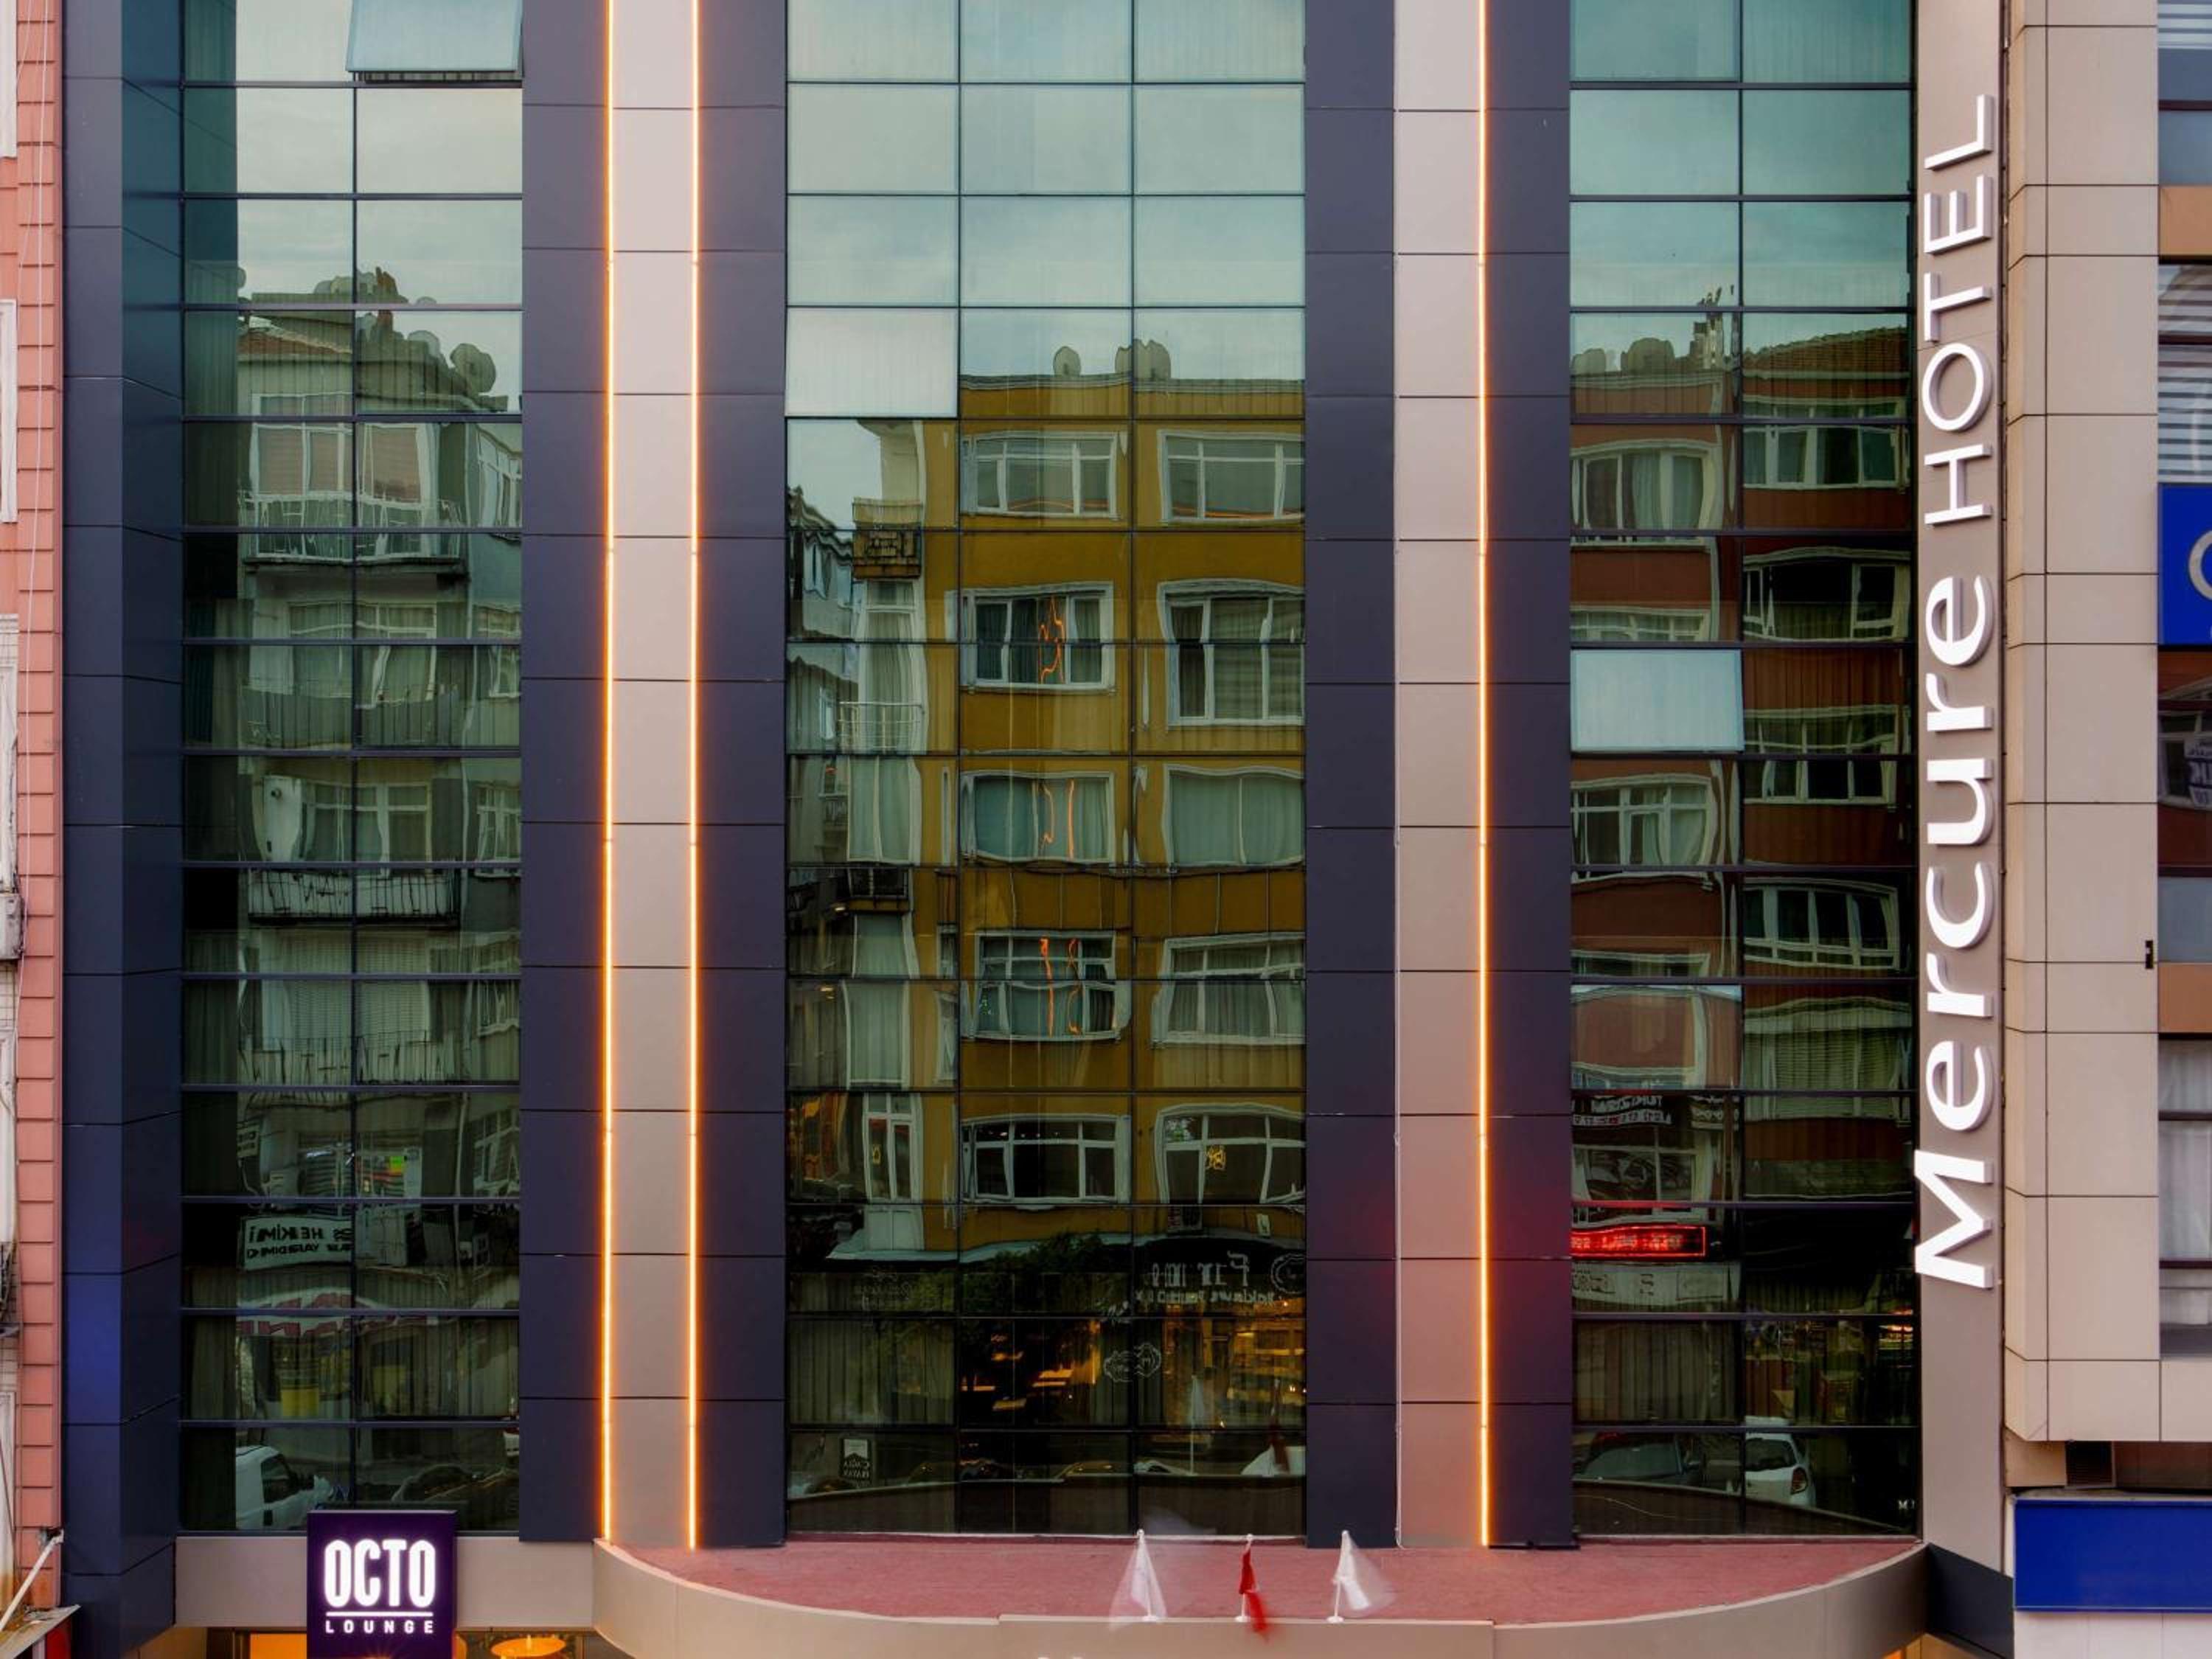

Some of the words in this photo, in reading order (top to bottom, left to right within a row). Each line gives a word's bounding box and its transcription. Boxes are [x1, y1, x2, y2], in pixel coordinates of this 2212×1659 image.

[1921, 94, 1992, 526] HOTEL
[1914, 577, 1994, 1289] Mercure
[324, 1538, 437, 1608] OCTO
[325, 1619, 434, 1634] LOUNGE
